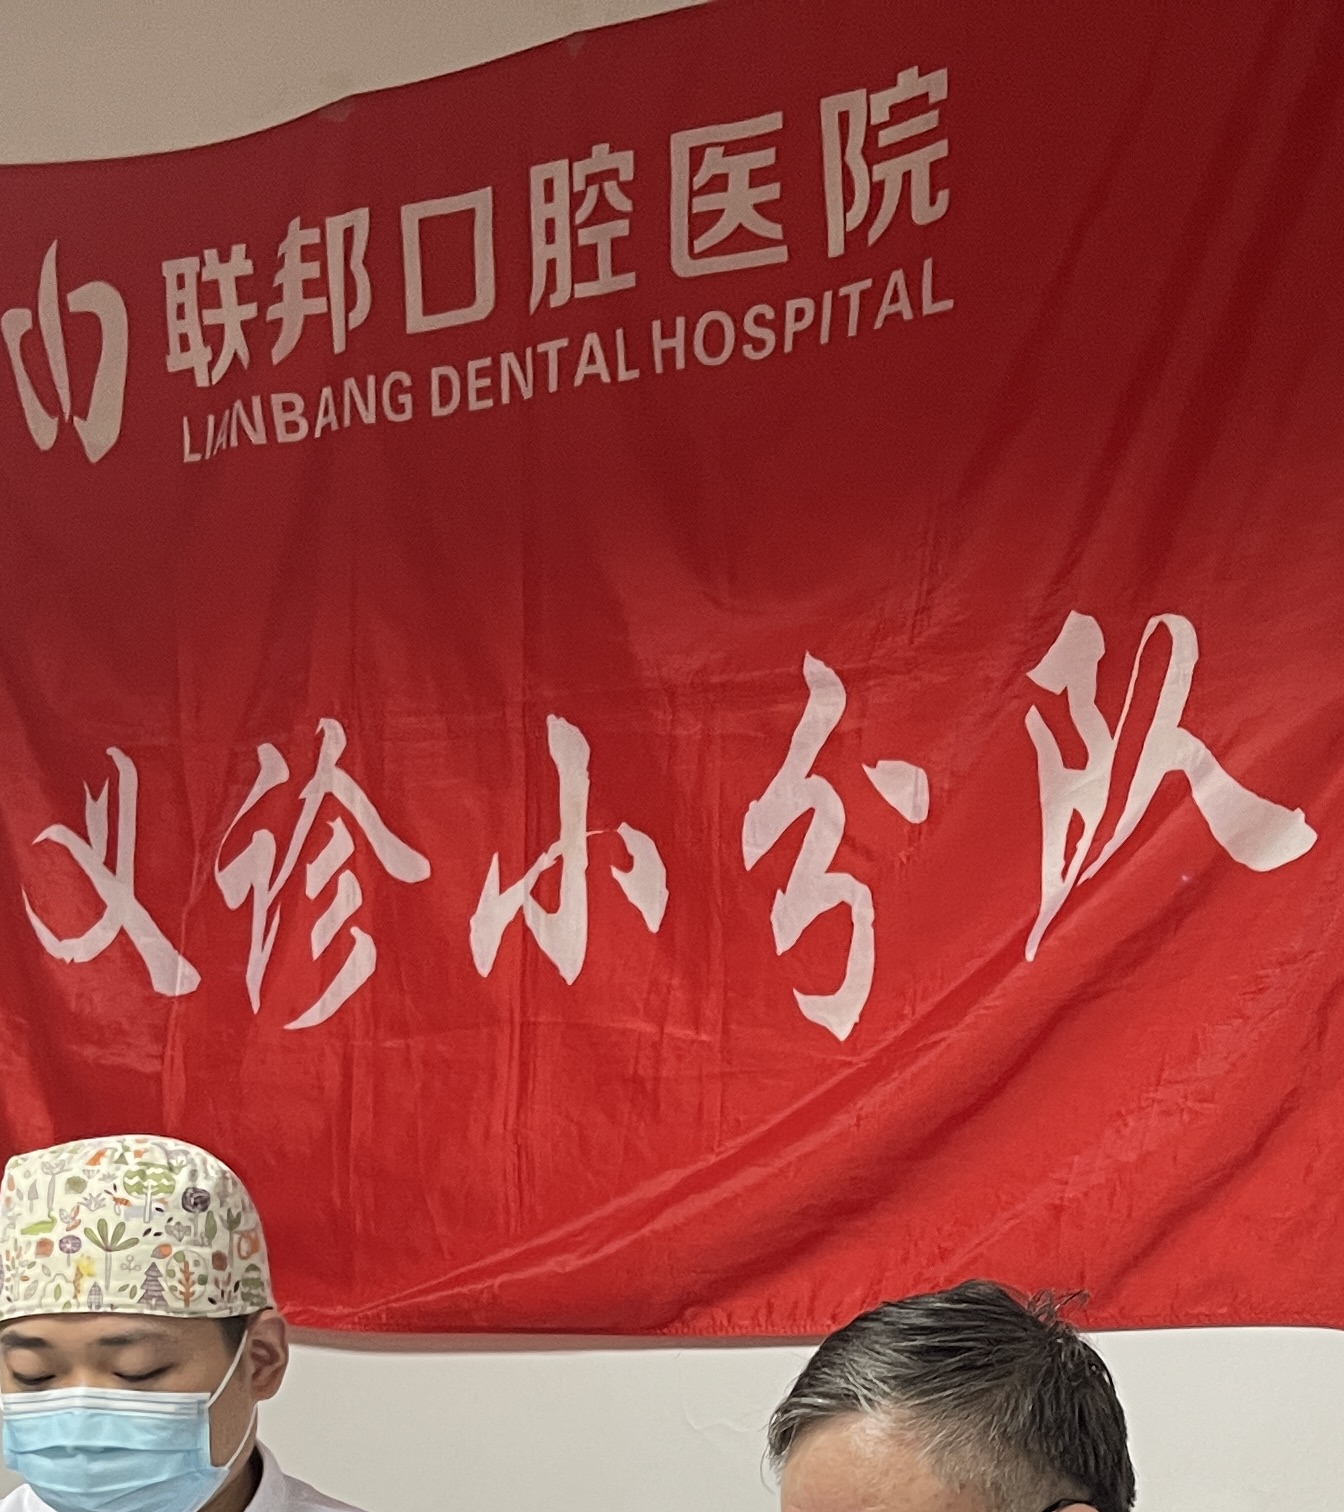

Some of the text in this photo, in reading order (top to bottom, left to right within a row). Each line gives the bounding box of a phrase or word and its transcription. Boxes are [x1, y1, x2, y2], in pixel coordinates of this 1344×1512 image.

[161, 65, 951, 388] 联邦口腔医院
[181, 256, 955, 464] LIANBANG DENTAL HOSPITAL
[21, 609, 1319, 1042] 义诊小分队
